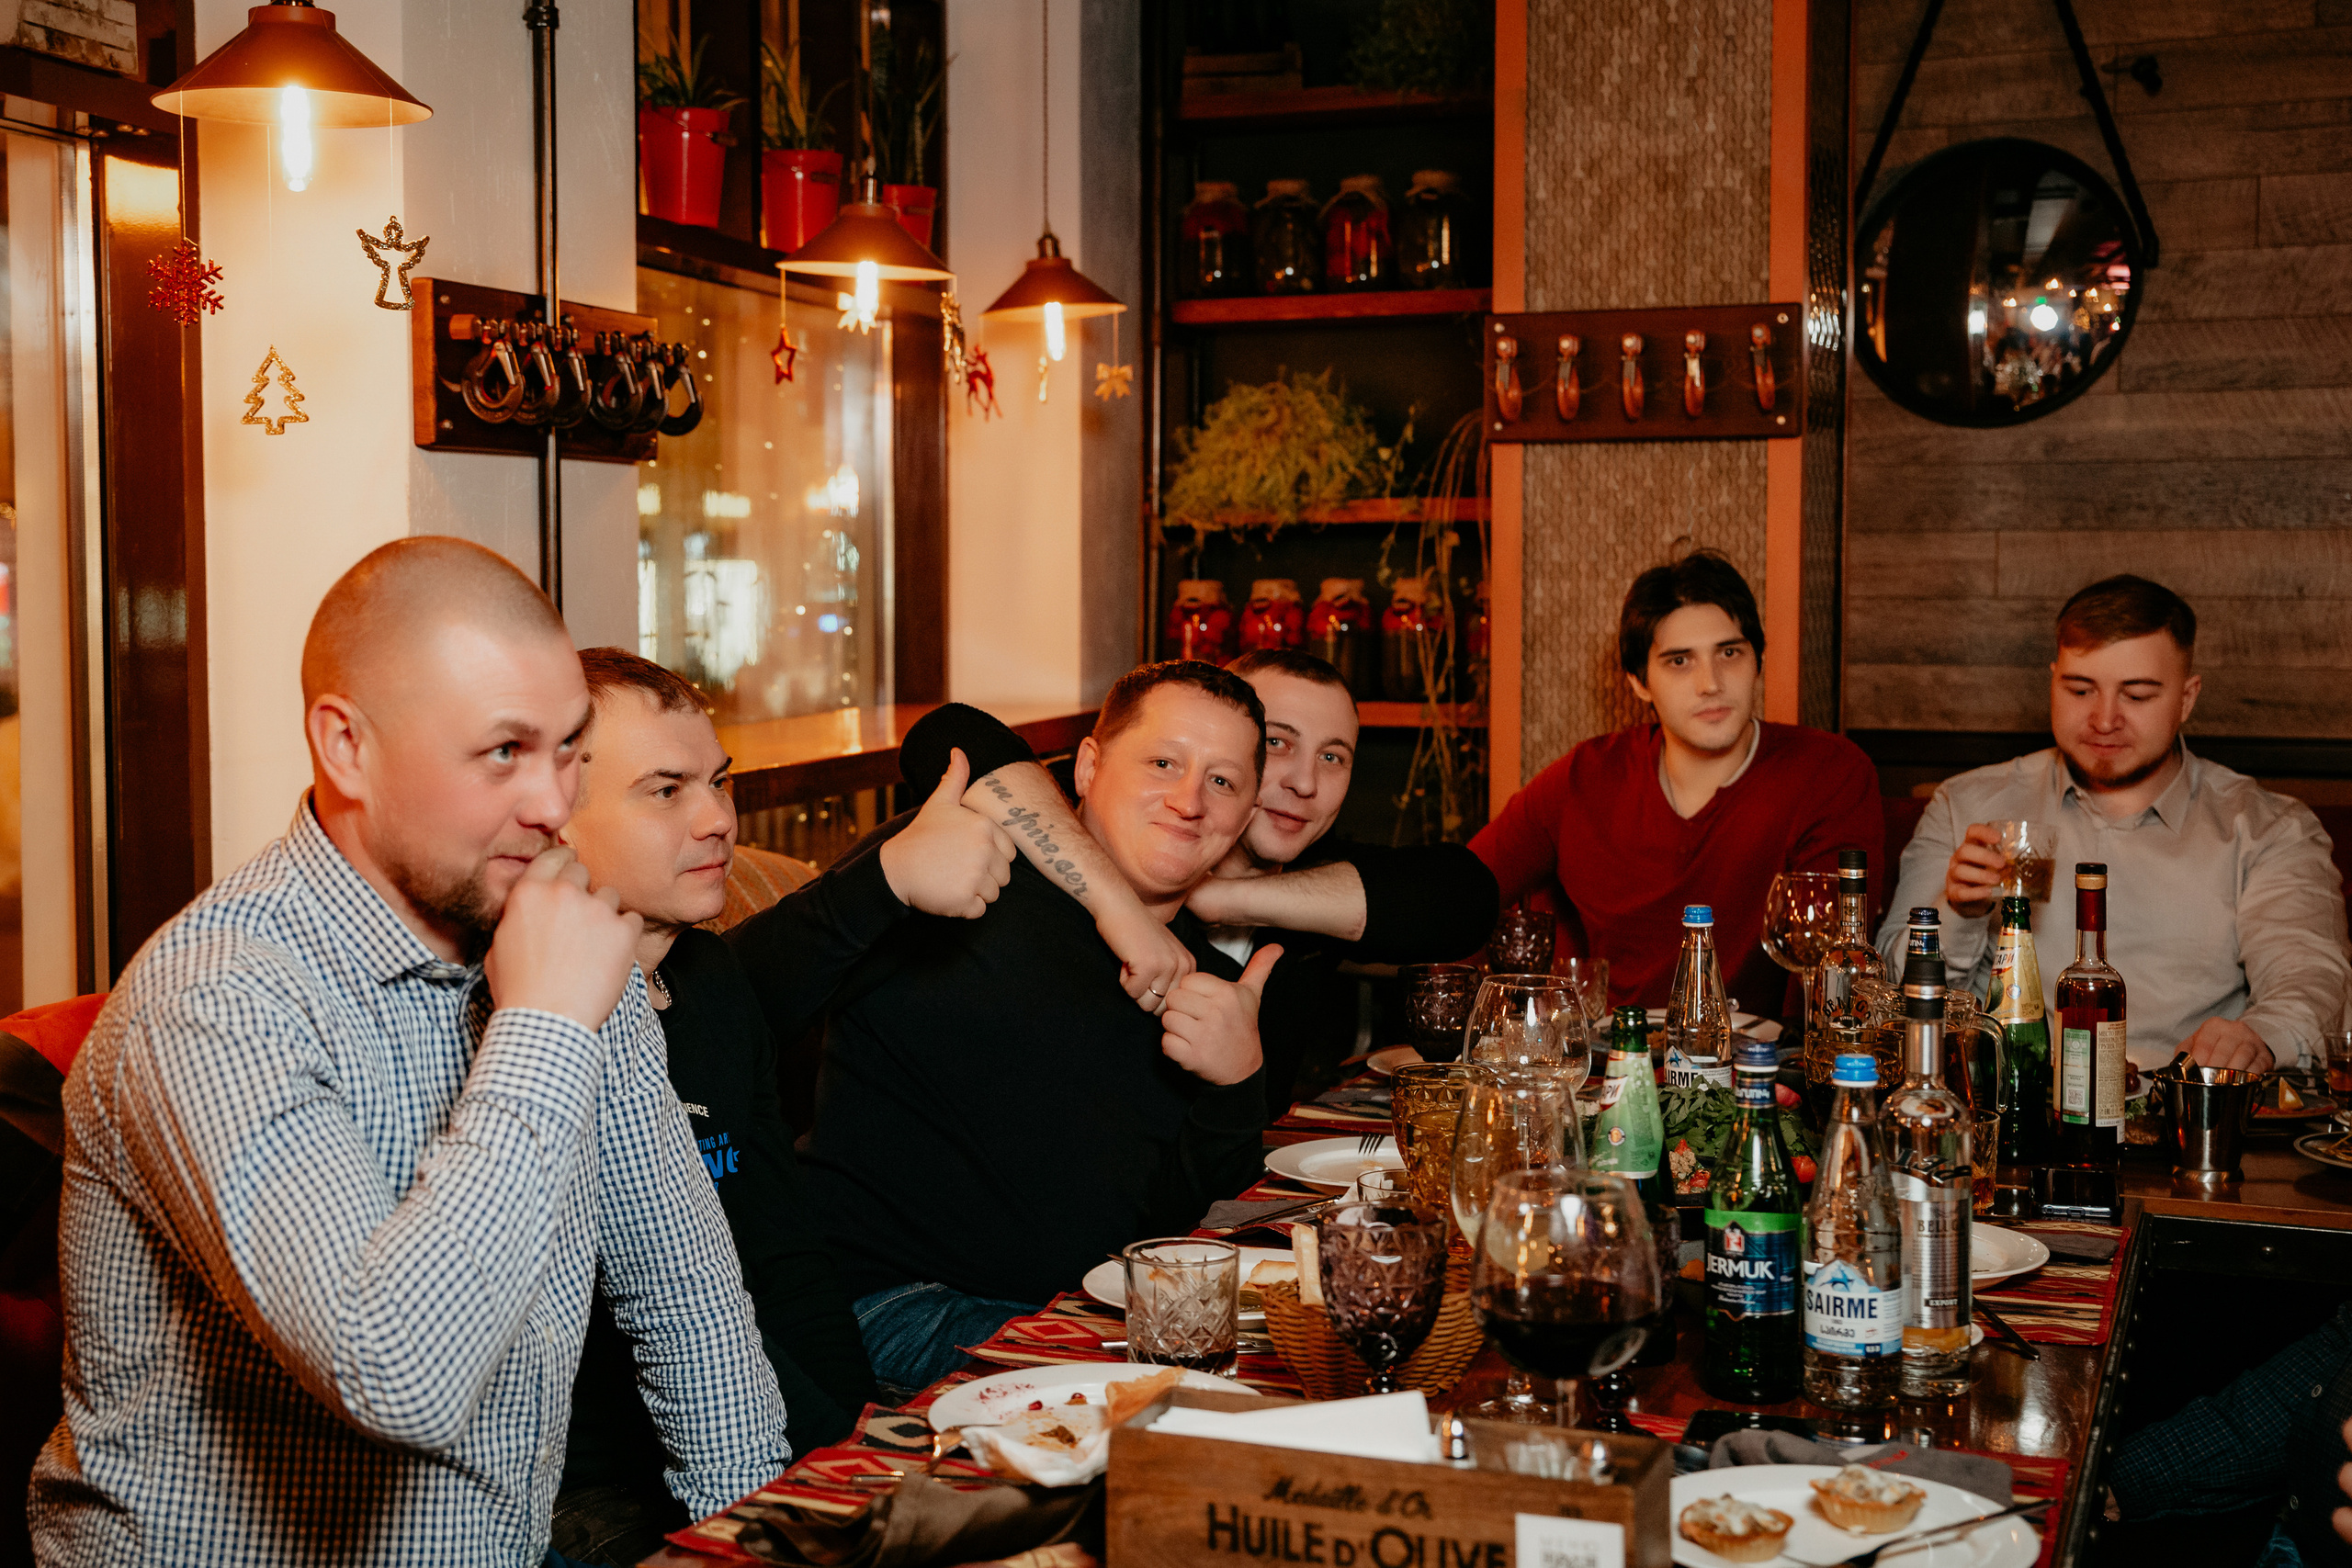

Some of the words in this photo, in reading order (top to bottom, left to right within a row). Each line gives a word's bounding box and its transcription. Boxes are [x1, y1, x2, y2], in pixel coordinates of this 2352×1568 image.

[1706, 1253, 1775, 1280] JERMUK
[1806, 1289, 1878, 1319] SAIRME
[1205, 1501, 1326, 1563] HUILE
